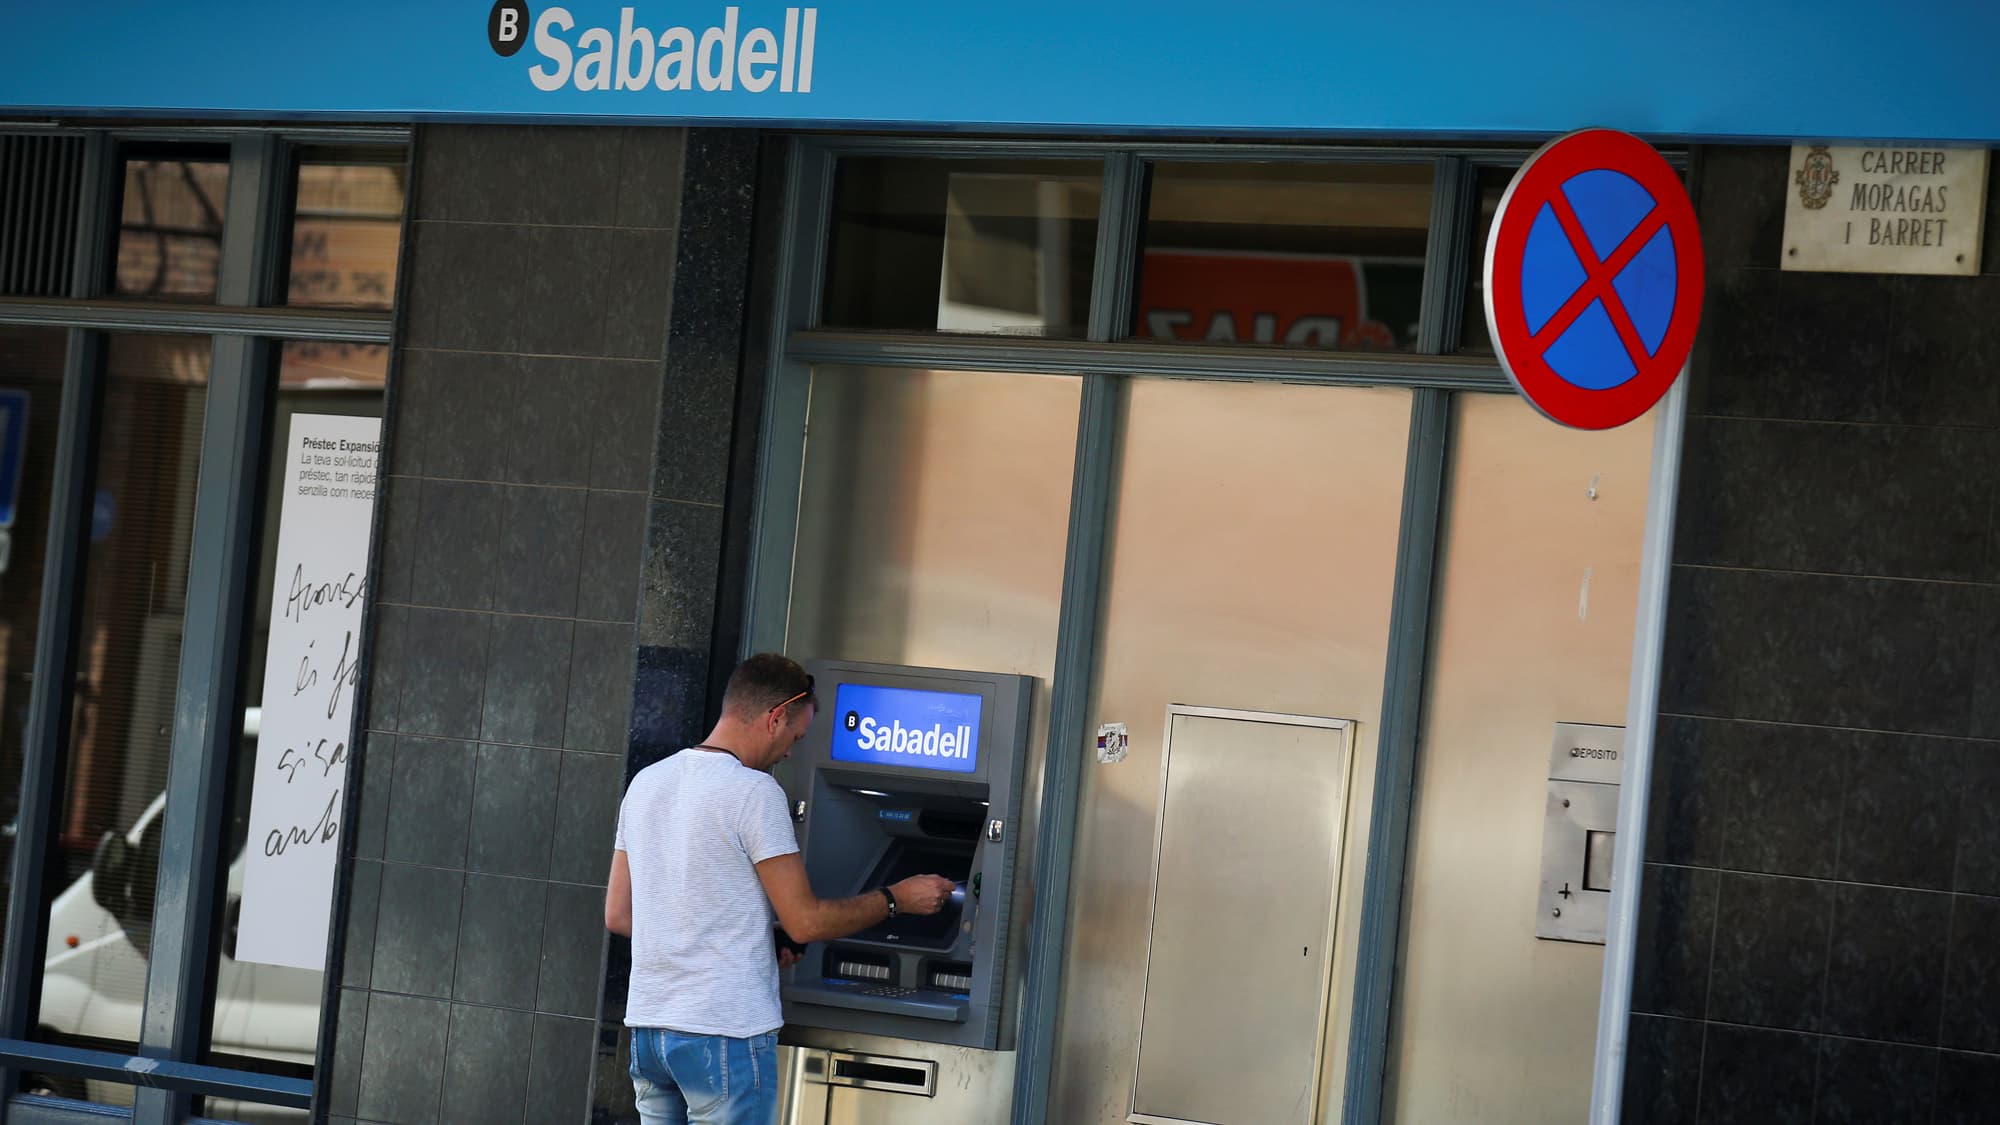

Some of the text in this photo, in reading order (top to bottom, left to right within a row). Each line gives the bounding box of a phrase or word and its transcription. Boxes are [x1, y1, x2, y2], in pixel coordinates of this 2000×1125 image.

[498, 6, 817, 93] B Sabadell
[1861, 151, 1945, 175] CARRER
[1850, 183, 1948, 213] MORAGAS
[1844, 218, 1947, 247] I BARRET
[303, 437, 336, 450] Préstec
[301, 453, 311, 465] La
[314, 454, 331, 466] teva
[336, 471, 348, 482] tan
[298, 485, 327, 497] senzilla
[330, 487, 348, 497] com
[848, 716, 971, 759] B Sabadell
